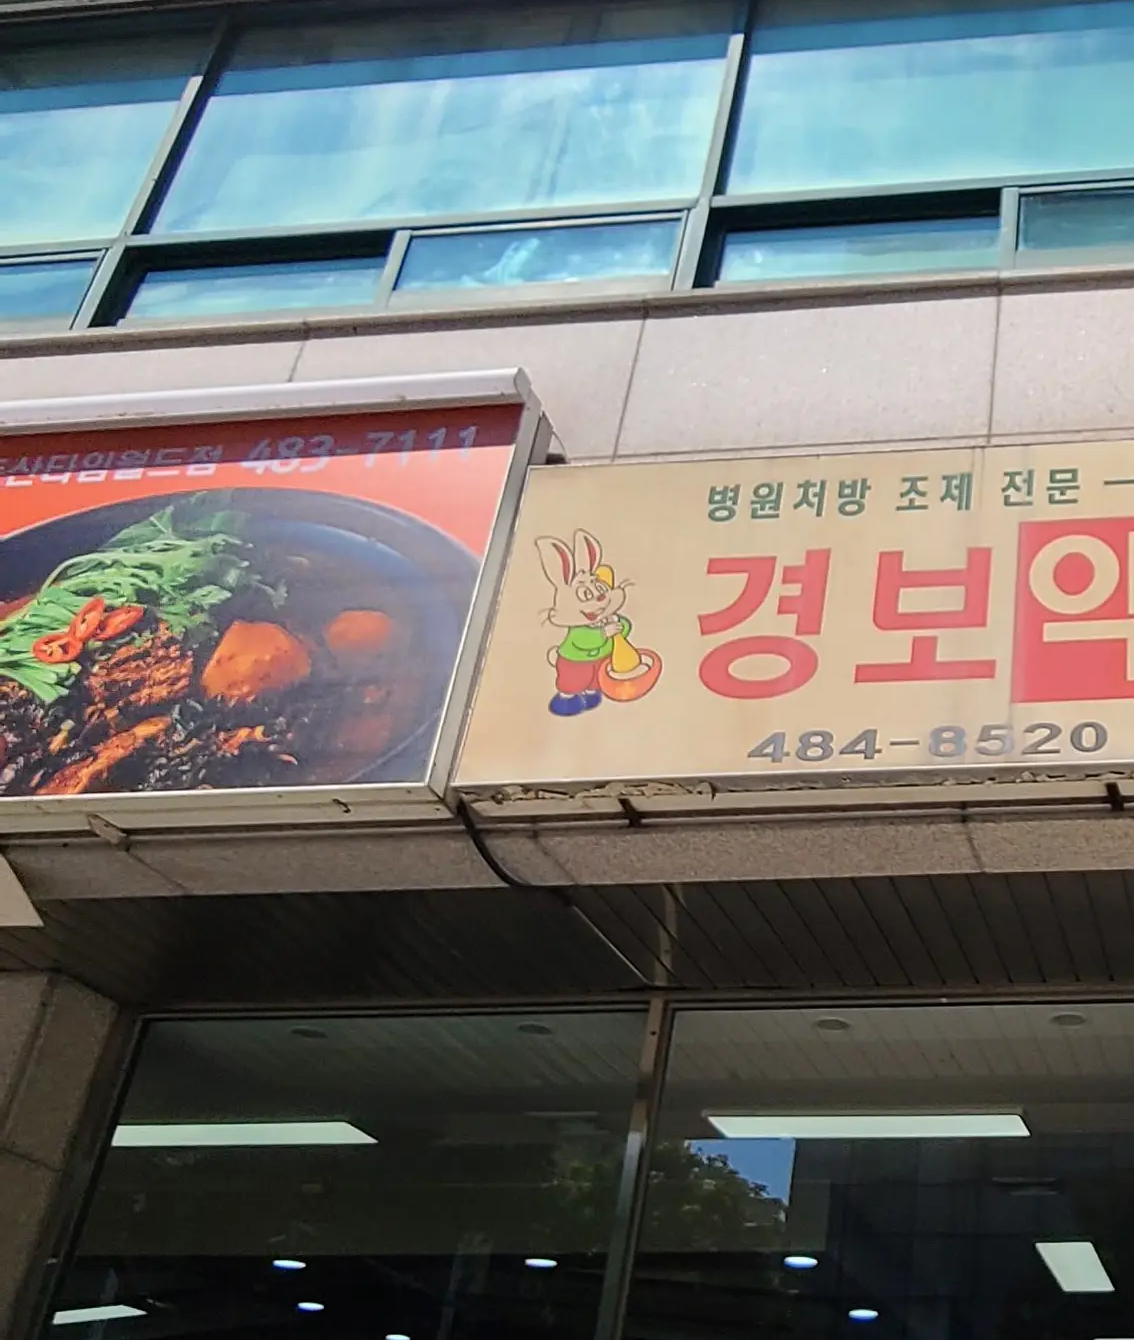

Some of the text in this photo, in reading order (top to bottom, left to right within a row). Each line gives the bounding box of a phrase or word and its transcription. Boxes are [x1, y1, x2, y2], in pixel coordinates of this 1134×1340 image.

[0, 426, 479, 487] 산타임월드점 483-7111
[707, 467, 1080, 522] 병원처방 조제 전문
[747, 721, 1109, 763] 484-8520
